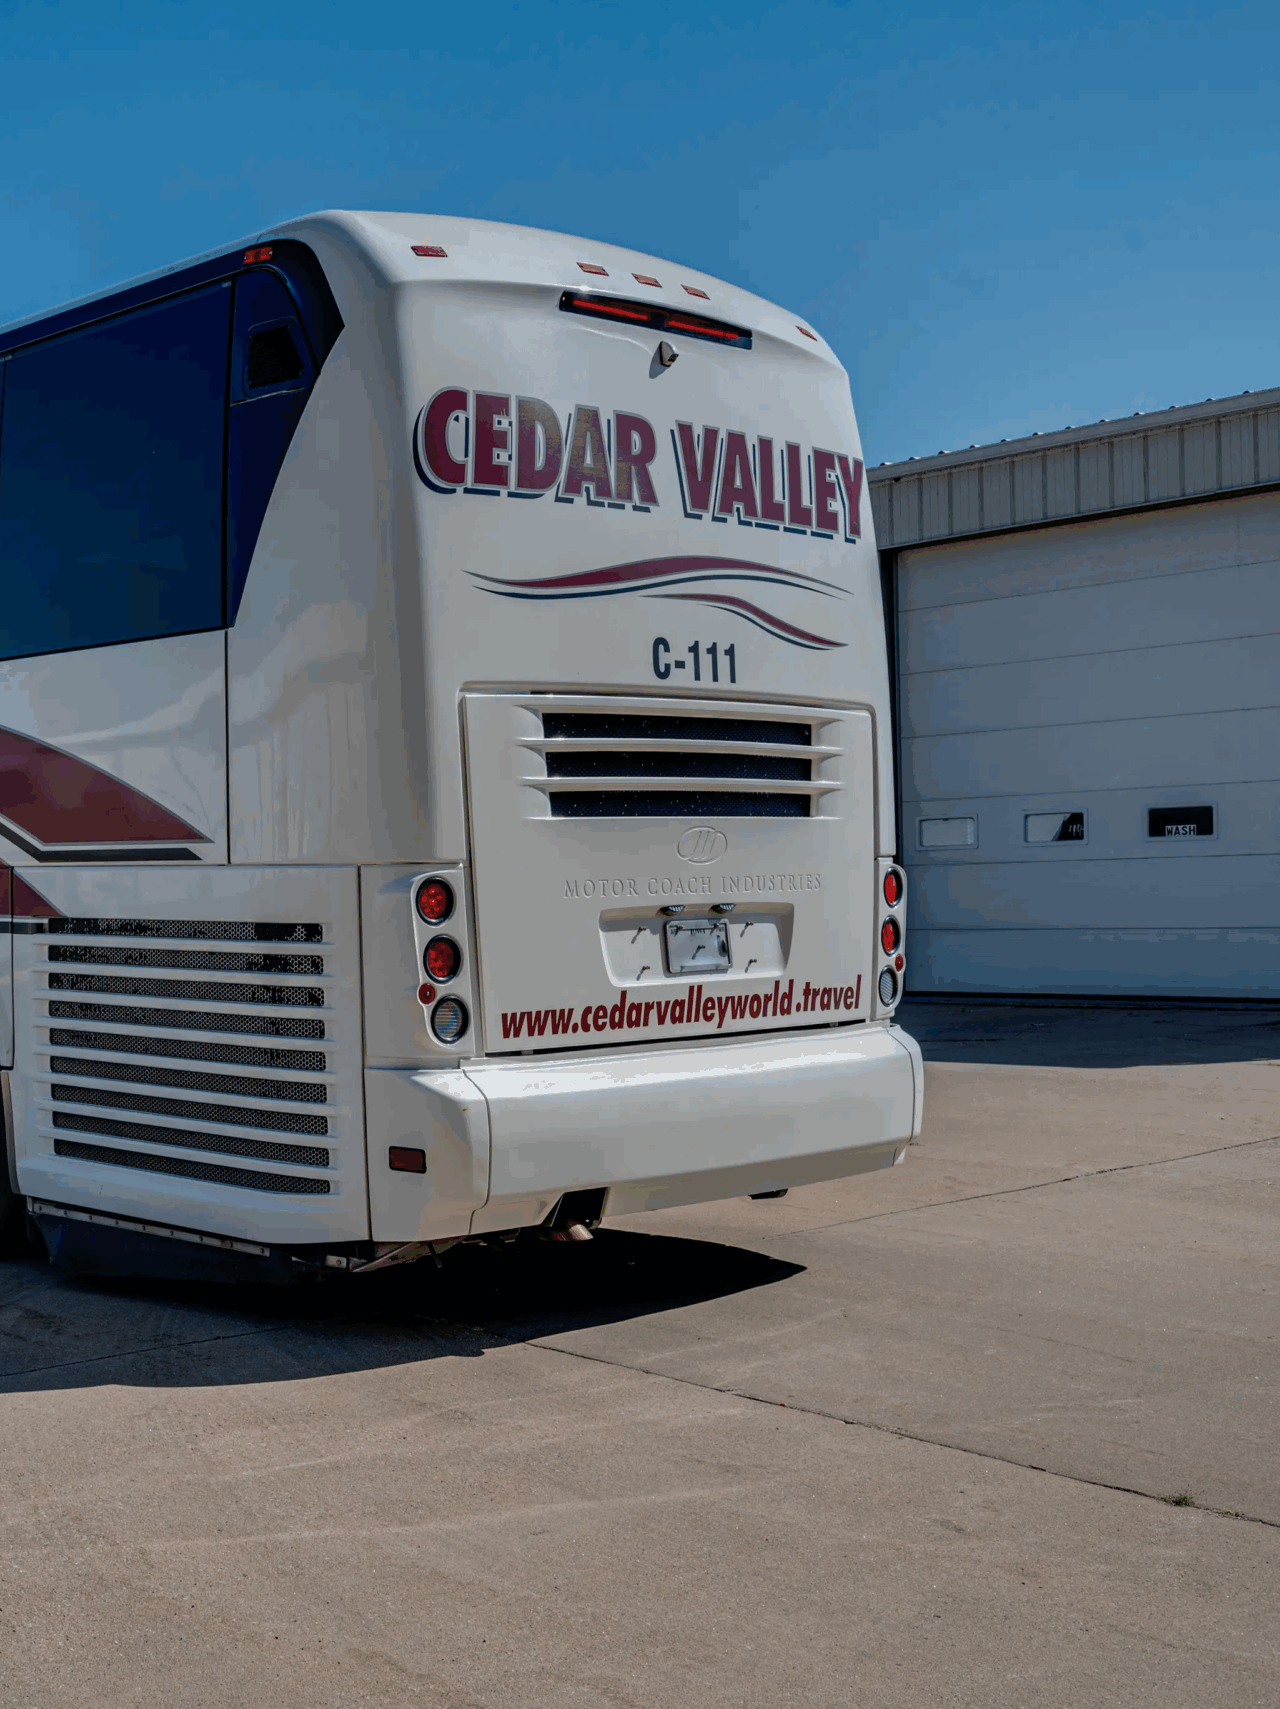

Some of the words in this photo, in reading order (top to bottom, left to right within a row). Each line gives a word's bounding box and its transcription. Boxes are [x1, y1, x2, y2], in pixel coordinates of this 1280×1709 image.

[412, 385, 660, 513] CEDAR
[670, 419, 864, 544] VALLEY
[652, 637, 736, 684] C-111
[1166, 825, 1196, 836] WASH
[563, 878, 639, 898] MOTOR
[648, 876, 711, 896] COACH
[720, 873, 821, 894] INDUSTRIES
[501, 974, 862, 1039] www.cedarvalleyworld.travel
